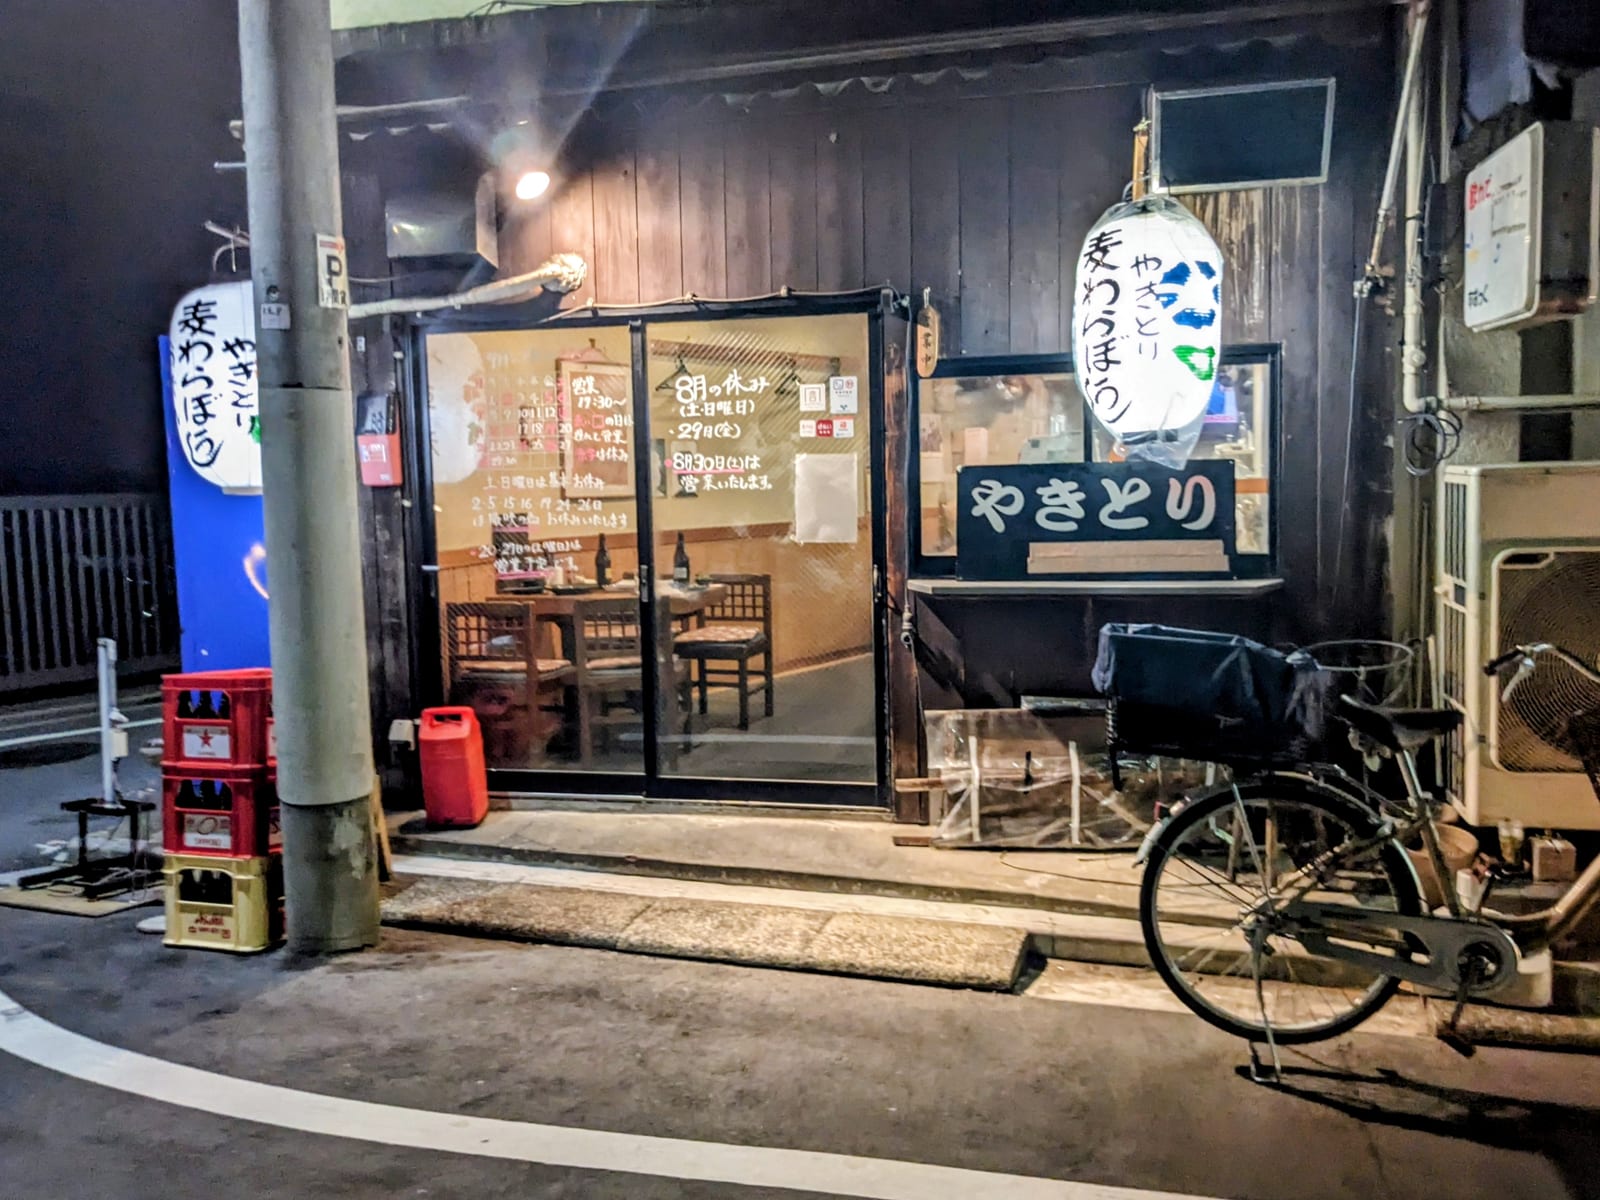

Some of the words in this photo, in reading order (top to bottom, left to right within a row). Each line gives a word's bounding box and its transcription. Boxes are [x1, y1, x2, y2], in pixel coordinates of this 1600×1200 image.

[1130, 253, 1162, 360] やきとり
[675, 369, 770, 403] 8月の休み
[970, 474, 1216, 533] やきとり
